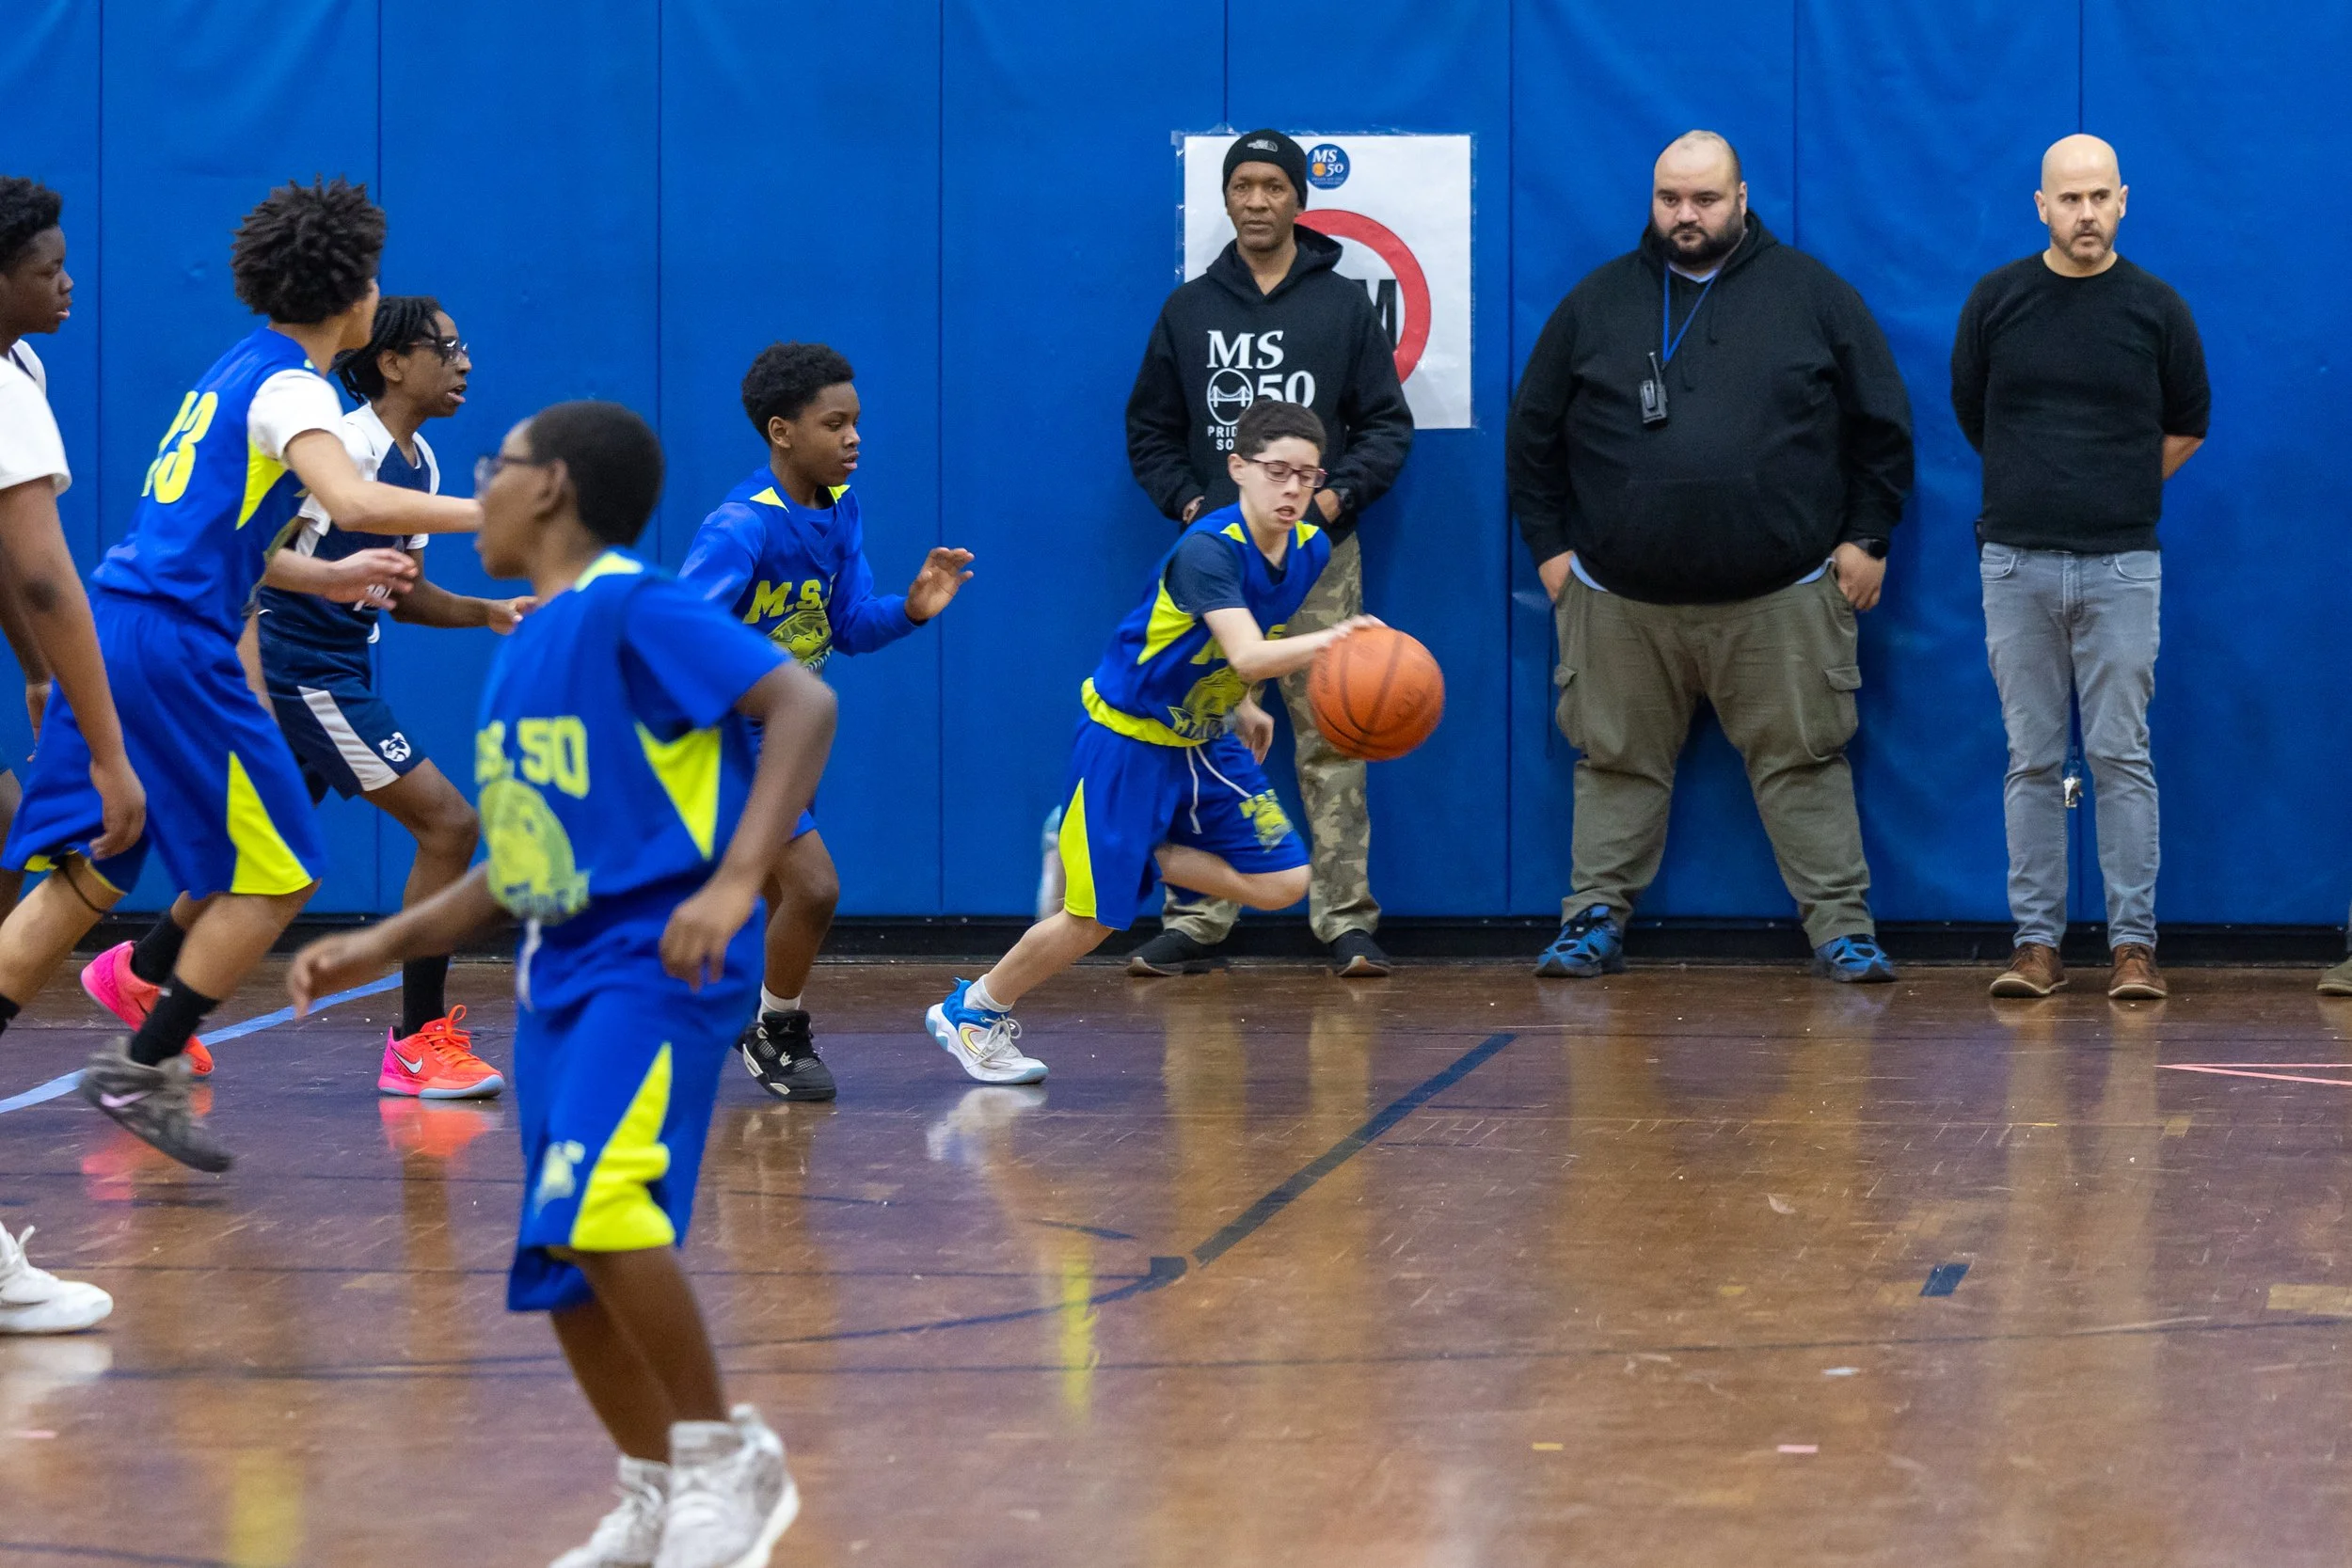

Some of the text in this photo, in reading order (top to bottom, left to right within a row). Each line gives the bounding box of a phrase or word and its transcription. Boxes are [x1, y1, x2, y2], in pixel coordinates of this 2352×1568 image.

[1312, 149, 1337, 163] MS
[1326, 163, 1344, 177] 50
[1206, 329, 1284, 370] MS
[1257, 370, 1316, 409] 50
[516, 715, 591, 800] 50
